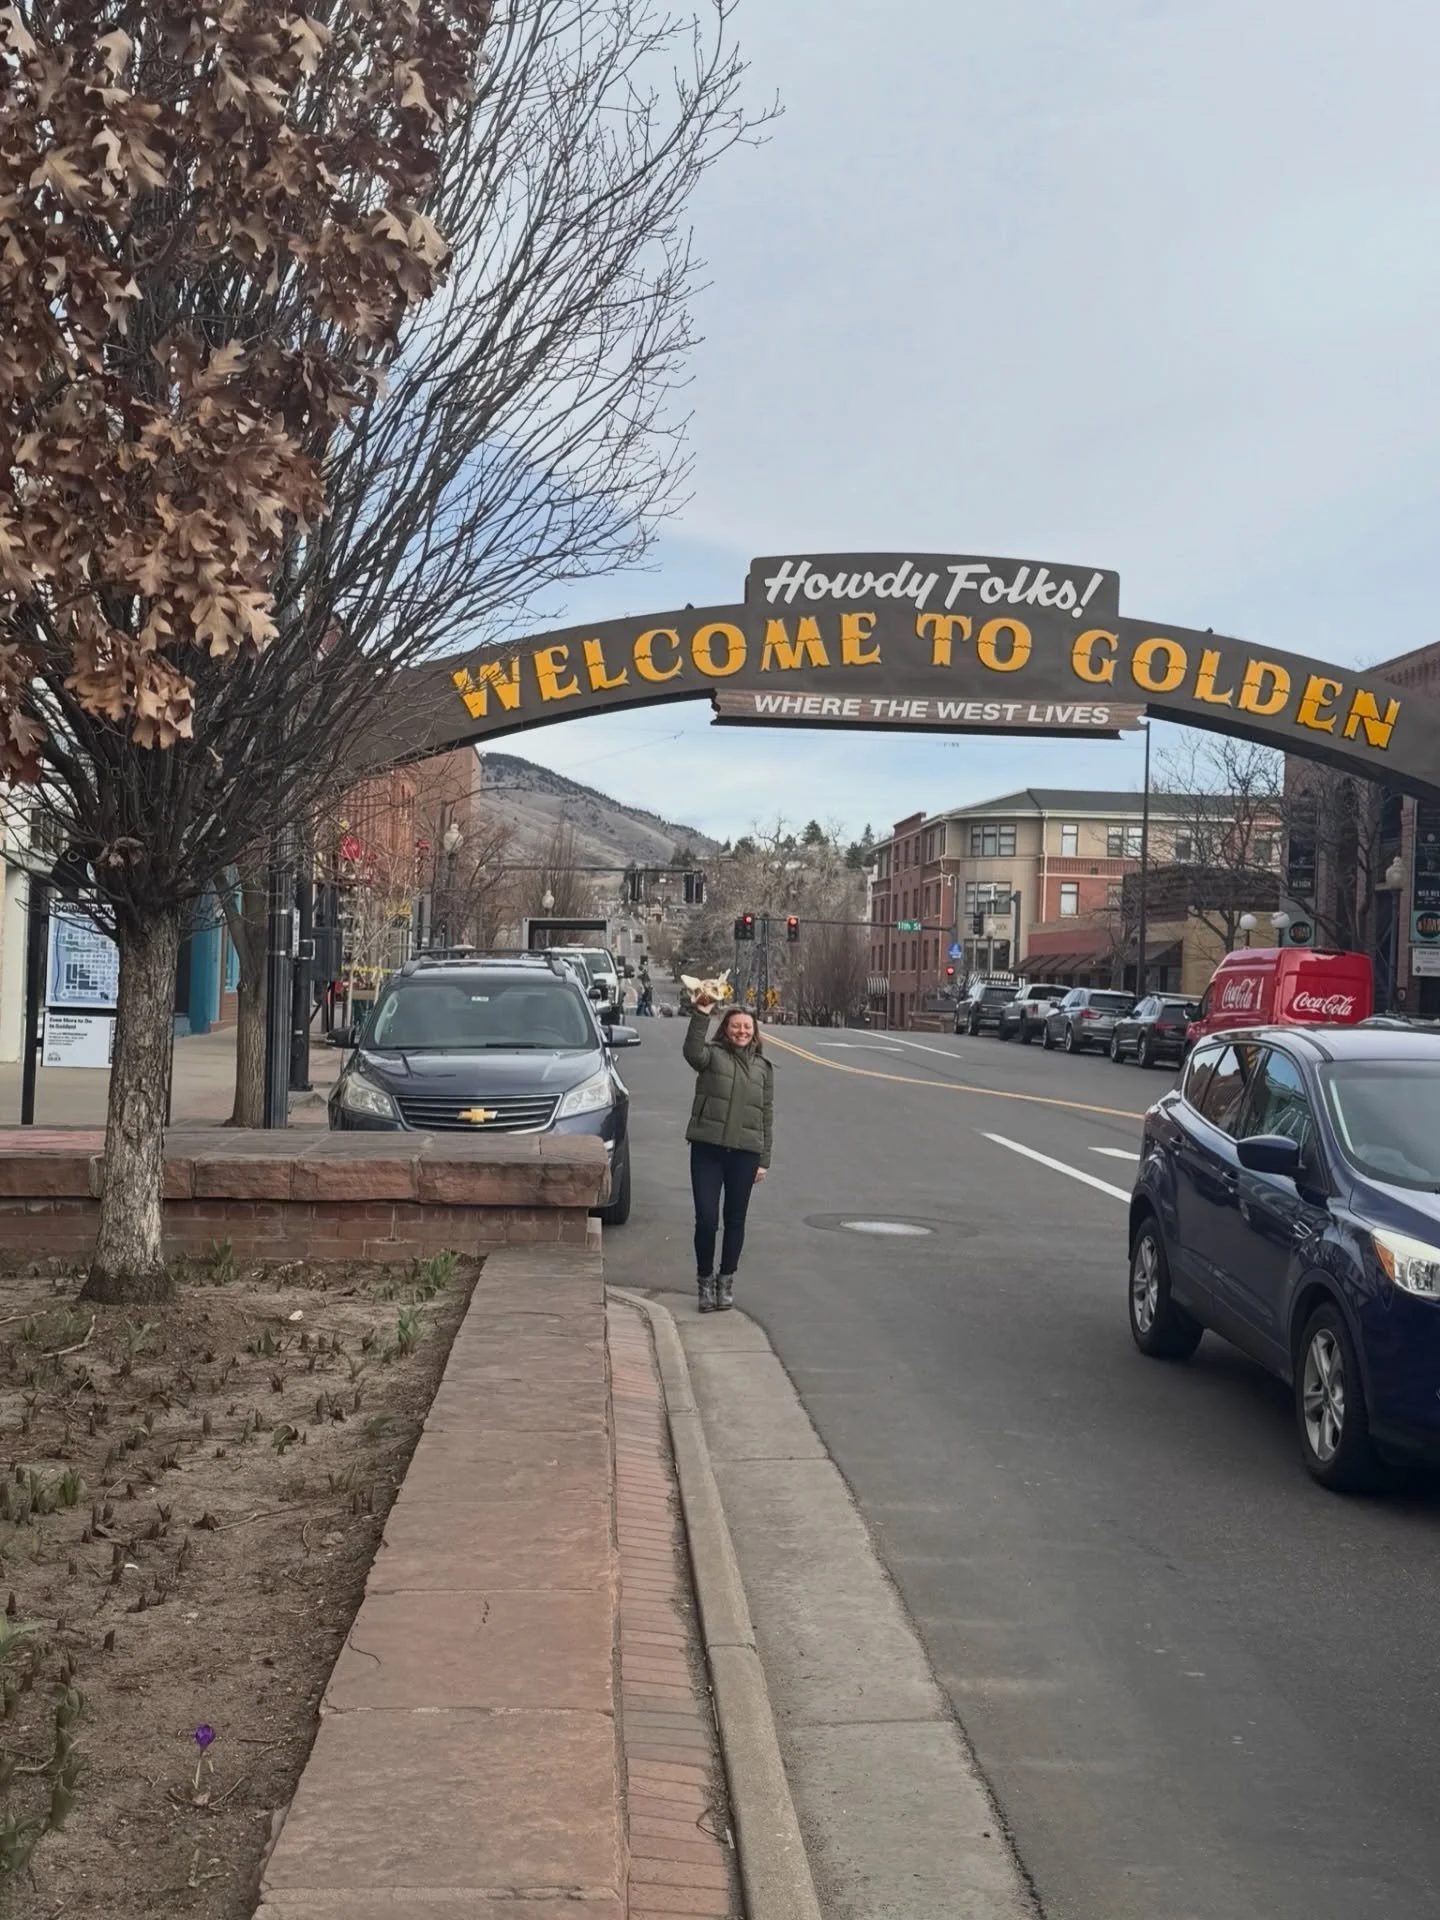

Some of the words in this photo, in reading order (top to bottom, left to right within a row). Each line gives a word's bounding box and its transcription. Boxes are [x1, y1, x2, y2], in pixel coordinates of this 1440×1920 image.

[764, 559, 940, 610] Howdy
[943, 563, 1104, 618] Folks!
[450, 611, 883, 721] WELCOME
[915, 612, 1033, 672] TO
[1071, 628, 1402, 750] GOLDEN
[753, 695, 863, 717] WHERE
[880, 699, 929, 719] THE
[936, 701, 1024, 722] WEST
[1027, 705, 1111, 724] LIVES
